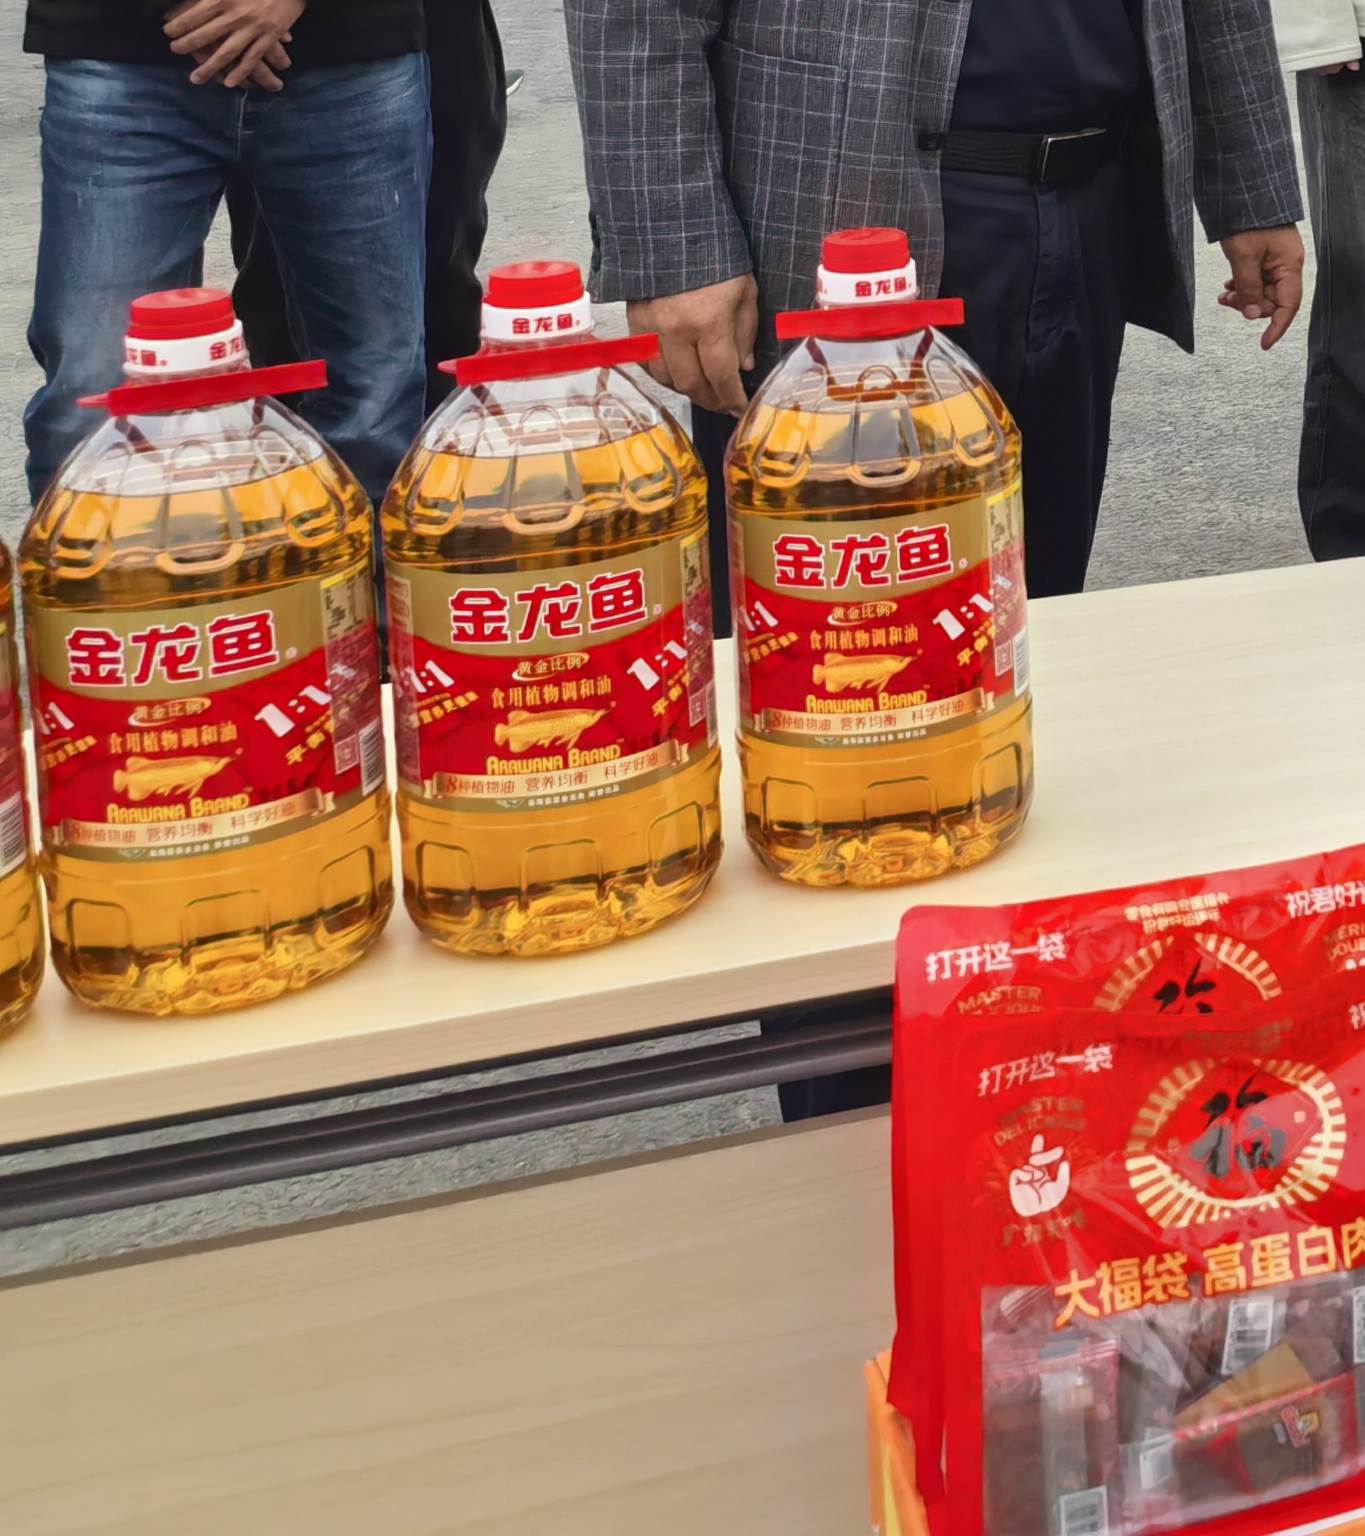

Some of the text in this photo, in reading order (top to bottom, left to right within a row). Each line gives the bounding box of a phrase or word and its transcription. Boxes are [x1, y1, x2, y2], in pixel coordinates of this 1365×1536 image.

[855, 276, 907, 298] 金龙鱼
[512, 313, 575, 334] 金龙鱼
[773, 524, 953, 589] 金龙鱼
[449, 568, 647, 645] 金龙鱼
[65, 610, 279, 687] 金龙鱼
[810, 624, 918, 651] 食用植物调和油
[491, 676, 612, 709] 食用植物调和油
[807, 690, 927, 713] ARAWANA BRAND
[840, 713, 897, 731] 营养均衡
[109, 724, 239, 755] 食用植物调和油
[487, 746, 620, 776] ARAWANA BRAND
[525, 772, 588, 793] 营养均衡
[107, 794, 250, 824] ARAWANA BRAND
[146, 822, 214, 843] 营养均衡
[925, 933, 1067, 984] 打开这一袋
[957, 985, 1042, 1016] MASTER
[977, 1043, 1115, 1097] 打开这一袋
[1053, 1250, 1192, 1330] 大福袋
